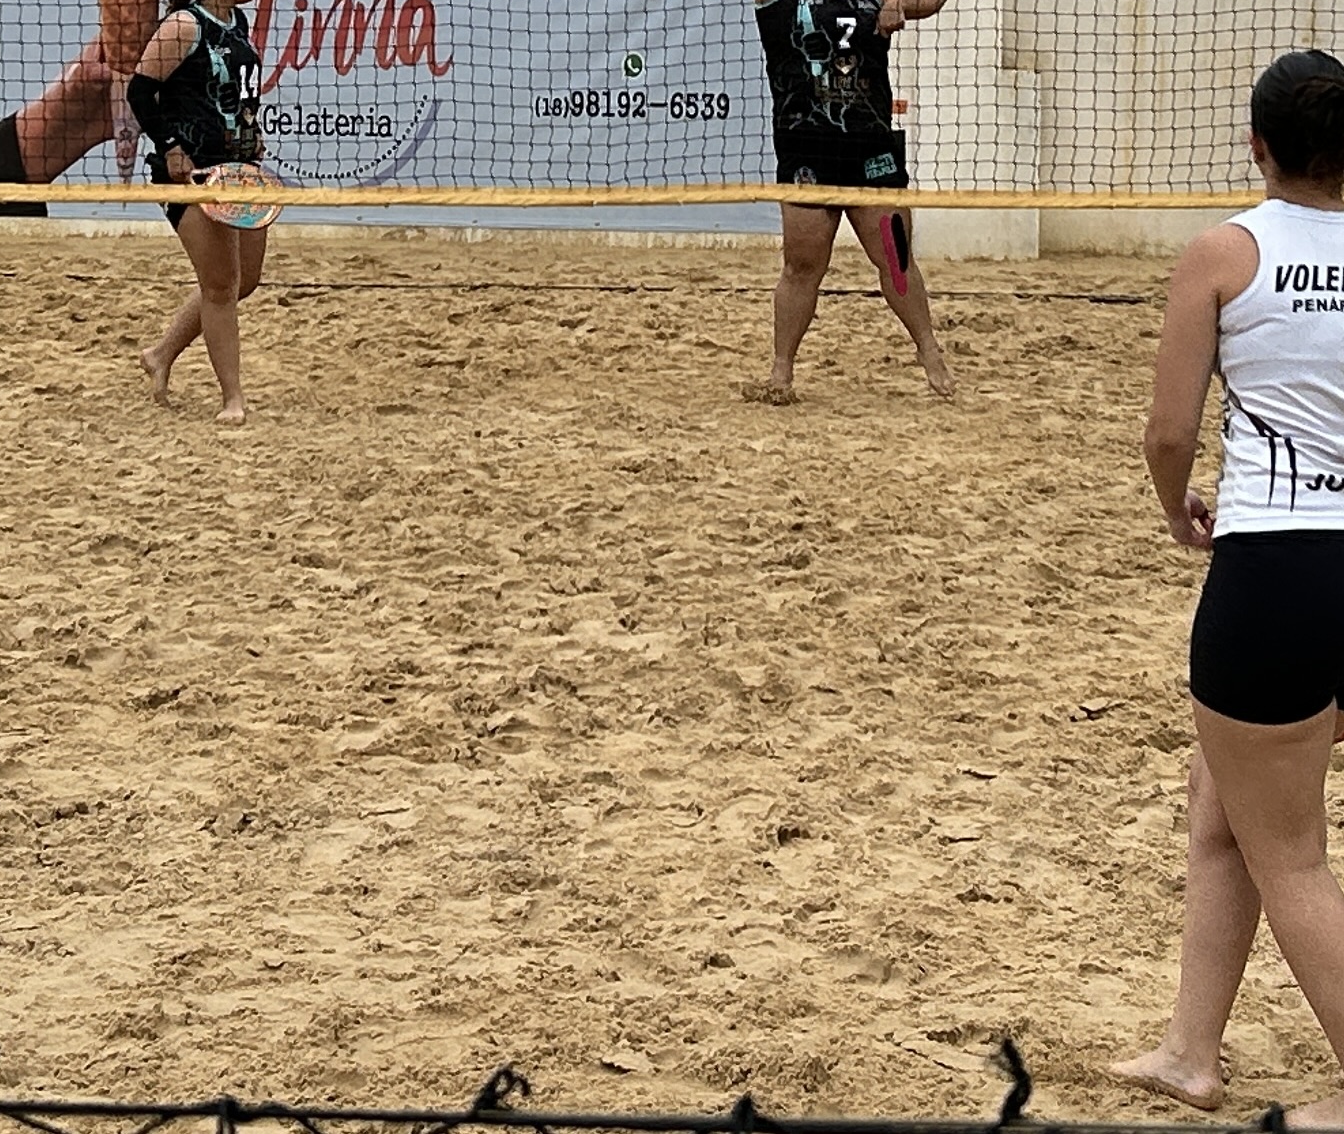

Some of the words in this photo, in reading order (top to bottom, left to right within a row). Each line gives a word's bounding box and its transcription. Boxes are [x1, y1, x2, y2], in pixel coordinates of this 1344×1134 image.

[836, 17, 857, 50] 7
[239, 63, 259, 101] 14
[262, 104, 393, 137] Gelateria
